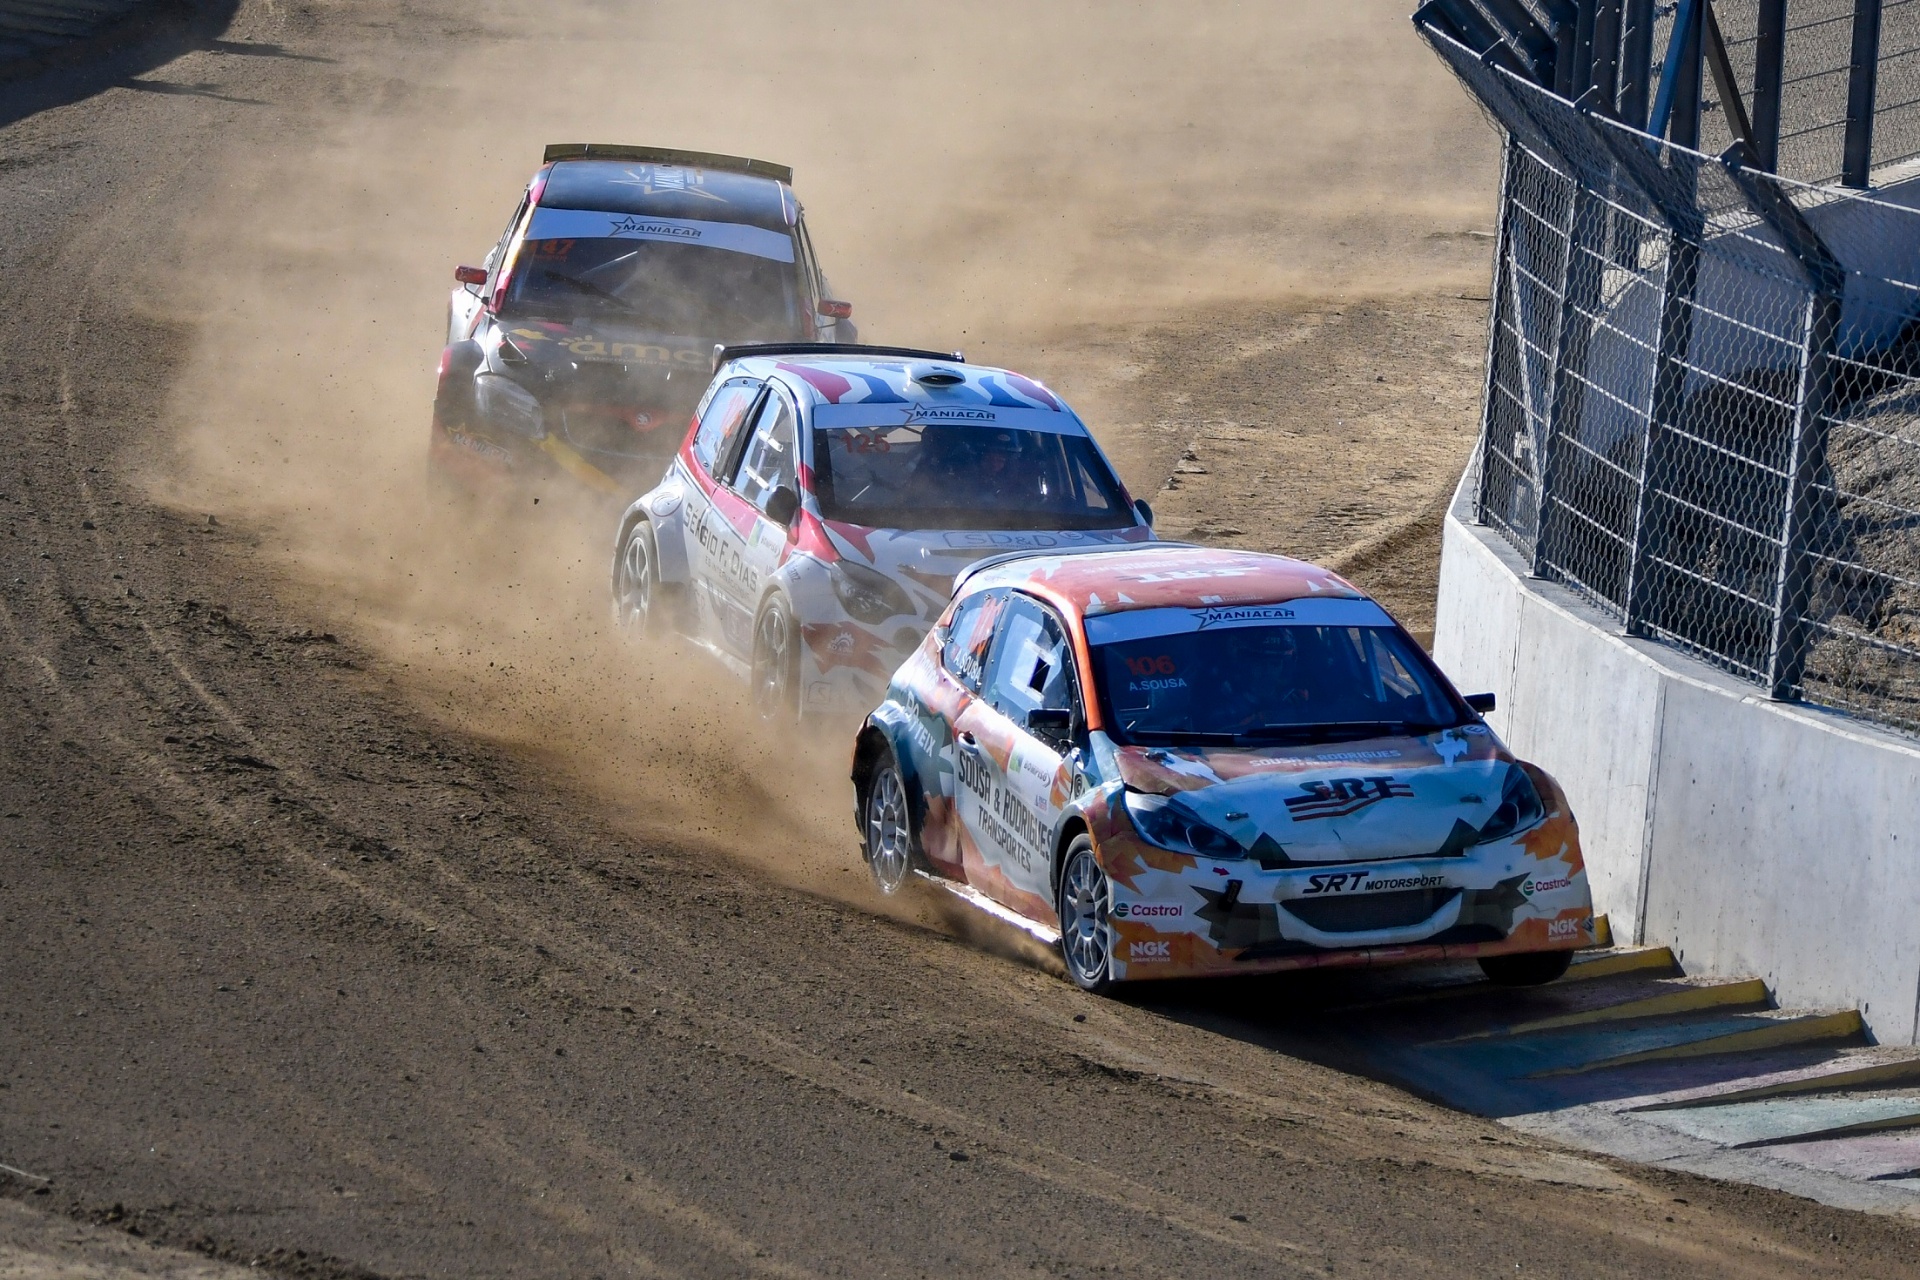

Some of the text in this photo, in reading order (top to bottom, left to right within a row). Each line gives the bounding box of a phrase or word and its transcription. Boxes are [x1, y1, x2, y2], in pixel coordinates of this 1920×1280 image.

[623, 224, 702, 237] MANIACAR
[915, 410, 996, 420] MANIACAR
[842, 433, 891, 454] 125
[730, 550, 758, 593] DIAS
[1208, 610, 1295, 621] MANIACAR
[1125, 655, 1176, 676] 106
[1129, 678, 1188, 692] A.SOUSA
[1249, 756, 1302, 767] SOUSA
[1317, 750, 1402, 761] RODRIGUES
[958, 749, 1053, 862] SOUSA & RODRIGUES
[978, 804, 1031, 874] TRANSPORTES
[1302, 871, 1445, 894] SRT MOTORSPORT
[1535, 878, 1569, 892] Castrol
[1131, 904, 1183, 917] Castrol
[1548, 918, 1578, 936] NGK
[1130, 941, 1170, 956] NGK
